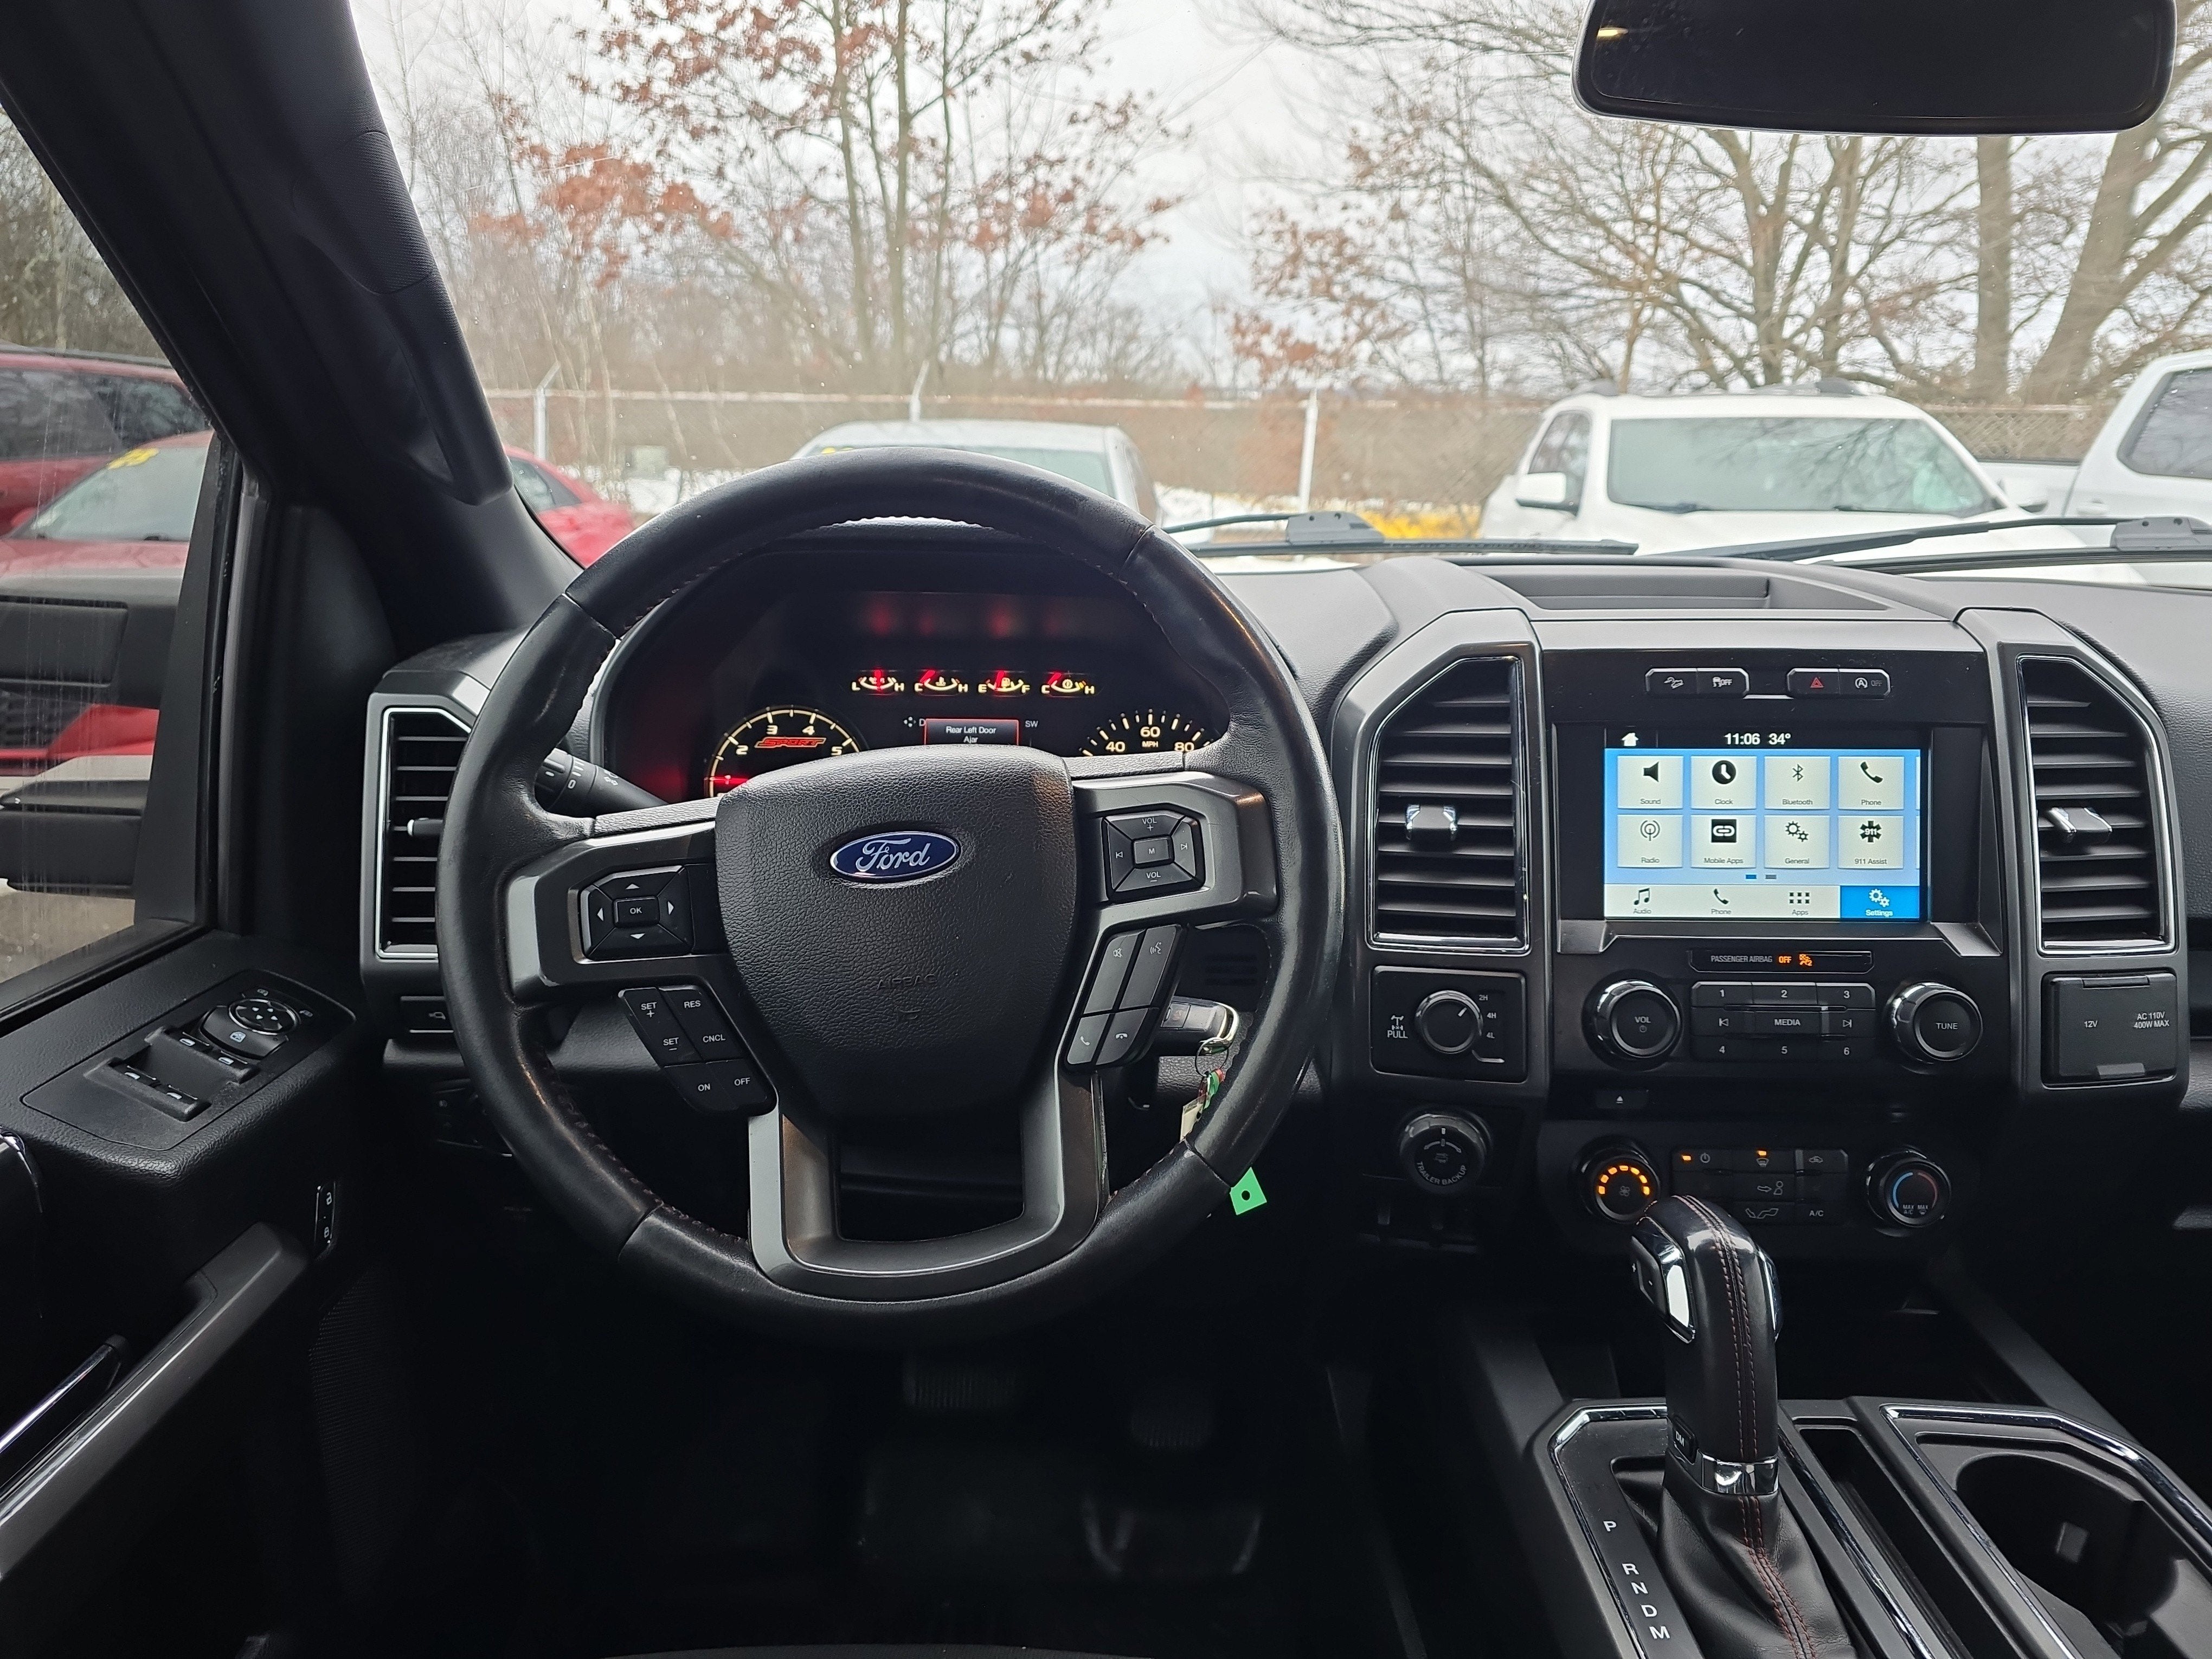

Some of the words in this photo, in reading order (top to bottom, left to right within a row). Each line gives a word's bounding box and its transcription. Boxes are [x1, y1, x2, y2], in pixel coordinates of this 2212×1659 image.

[852, 681, 860, 691] L
[895, 681, 904, 692] H
[915, 682, 923, 692] C
[958, 683, 968, 693] H
[978, 684, 987, 693] E
[1022, 684, 1030, 693] F
[1041, 684, 1050, 694] C
[1084, 685, 1095, 695] H
[767, 725, 778, 735] 3
[802, 725, 815, 735] 4
[946, 726, 962, 734] Rear
[963, 725, 976, 734] Left
[979, 726, 996, 734] Door
[1140, 726, 1161, 737] 60
[963, 735, 978, 744] Ajar
[1724, 733, 1760, 745] 11:06
[736, 745, 749, 755] 2
[831, 746, 843, 756] 5
[1105, 741, 1126, 753] 40
[1174, 742, 1194, 752] 80
[856, 838, 931, 872] Ford
[1866, 909, 1893, 918] Settings
[1719, 989, 1725, 998] 1
[1781, 989, 1788, 998] 2
[1843, 990, 1850, 999] 3
[641, 1001, 657, 1010] SET
[684, 1000, 701, 1008] RES
[2084, 1020, 2098, 1028] 12V
[2133, 1021, 2153, 1029] 400W
[703, 1034, 726, 1043] CNCL
[1387, 1030, 1409, 1038] PULL
[663, 1037, 679, 1046] SET
[1719, 1046, 1725, 1054] 4
[1781, 1046, 1788, 1054] 5
[1843, 1047, 1850, 1056] 6
[734, 1077, 751, 1085] OFF
[698, 1083, 711, 1091] ON
[1417, 1161, 1441, 1185] TRAILER
[1442, 1165, 1467, 1185] BACKUP
[1603, 1520, 1617, 1532] P
[1622, 1563, 1639, 1576] R
[1631, 1581, 1649, 1594] N
[1641, 1604, 1657, 1617] D
[1649, 1626, 1671, 1639] M
